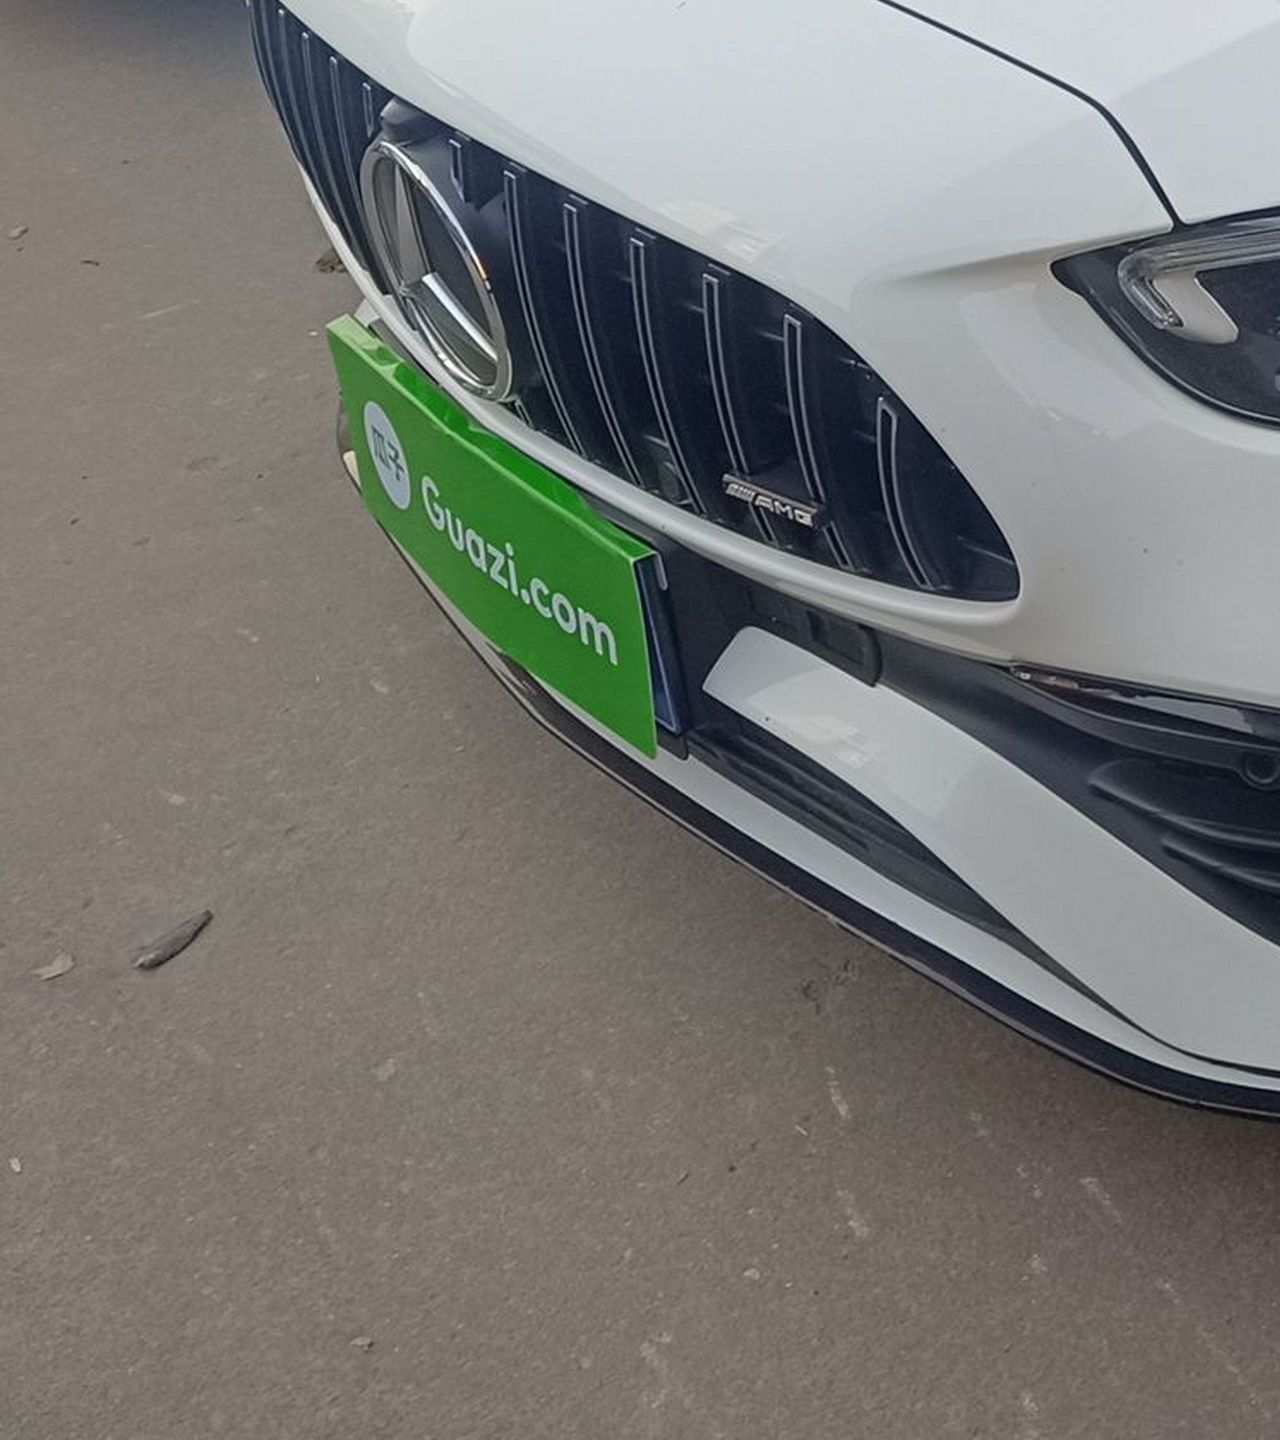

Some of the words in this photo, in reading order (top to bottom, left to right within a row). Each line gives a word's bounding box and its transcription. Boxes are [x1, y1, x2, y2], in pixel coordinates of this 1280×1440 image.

[371, 424, 404, 481] 瓜子
[755, 494, 813, 527] AMG
[421, 475, 618, 666] Guazi.com
